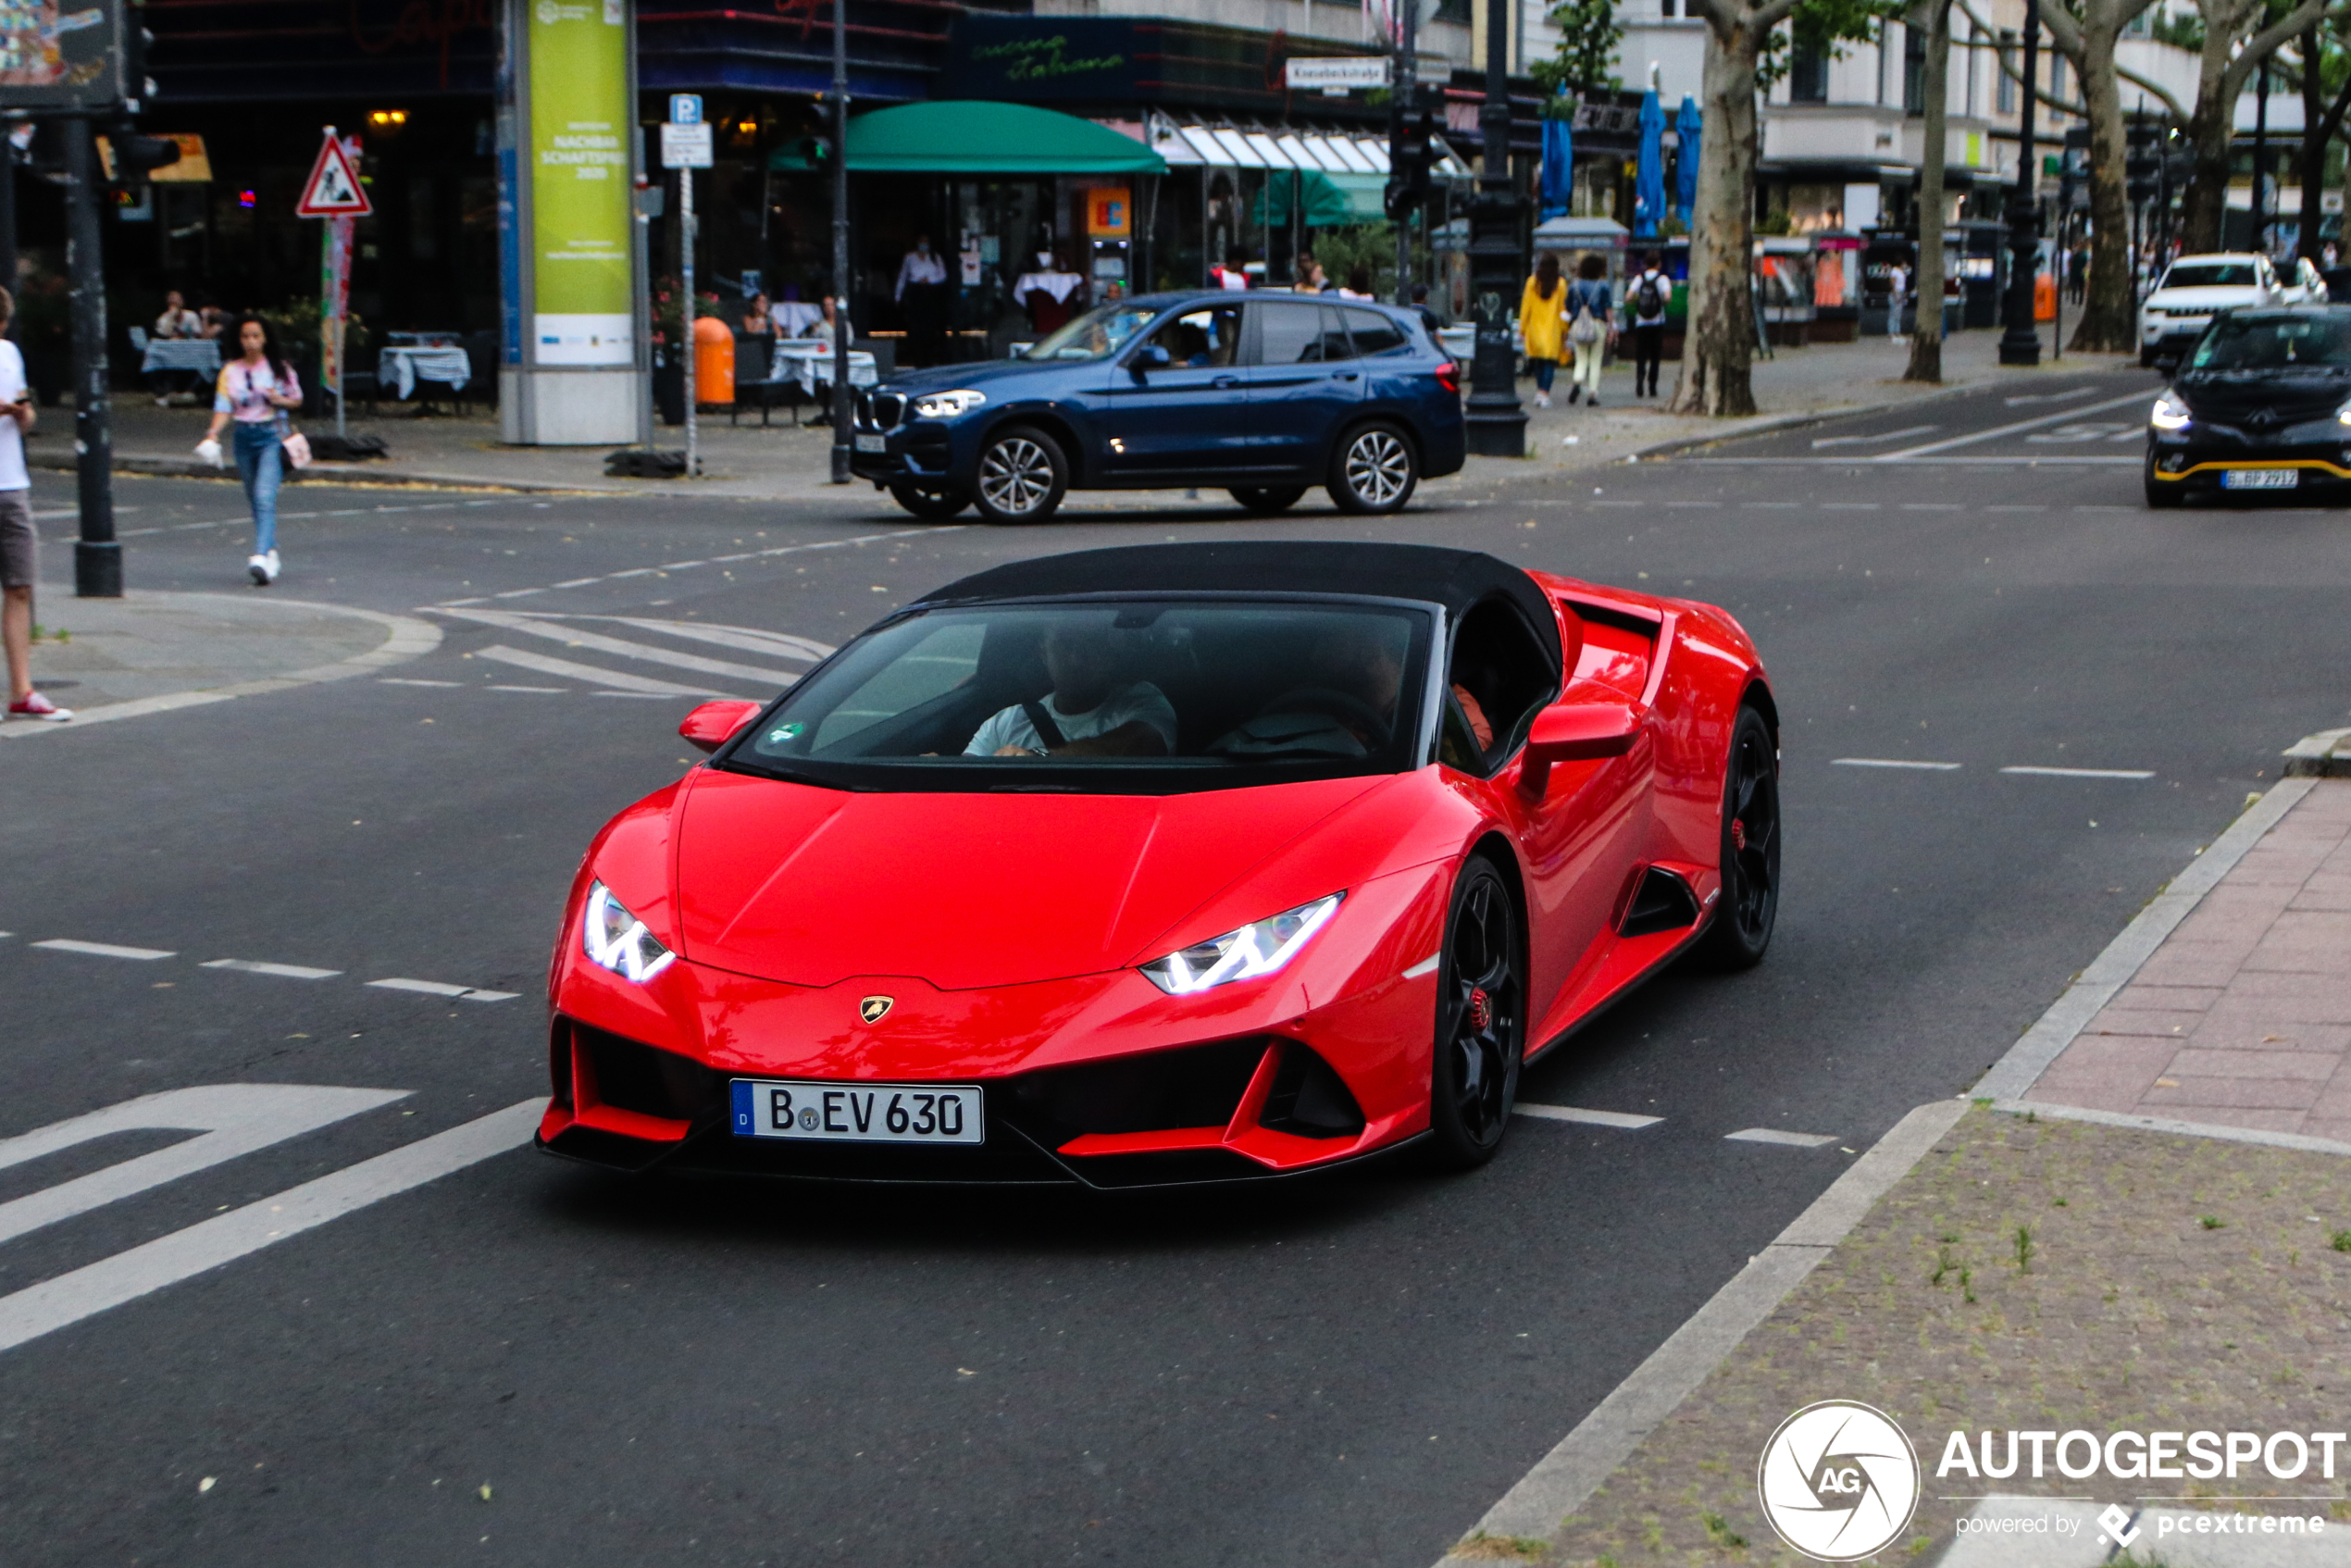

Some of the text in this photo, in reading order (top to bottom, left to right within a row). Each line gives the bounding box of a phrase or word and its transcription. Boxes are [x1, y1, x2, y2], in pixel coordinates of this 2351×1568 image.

[740, 1114, 748, 1126] D
[770, 1089, 964, 1135] B EV 630
